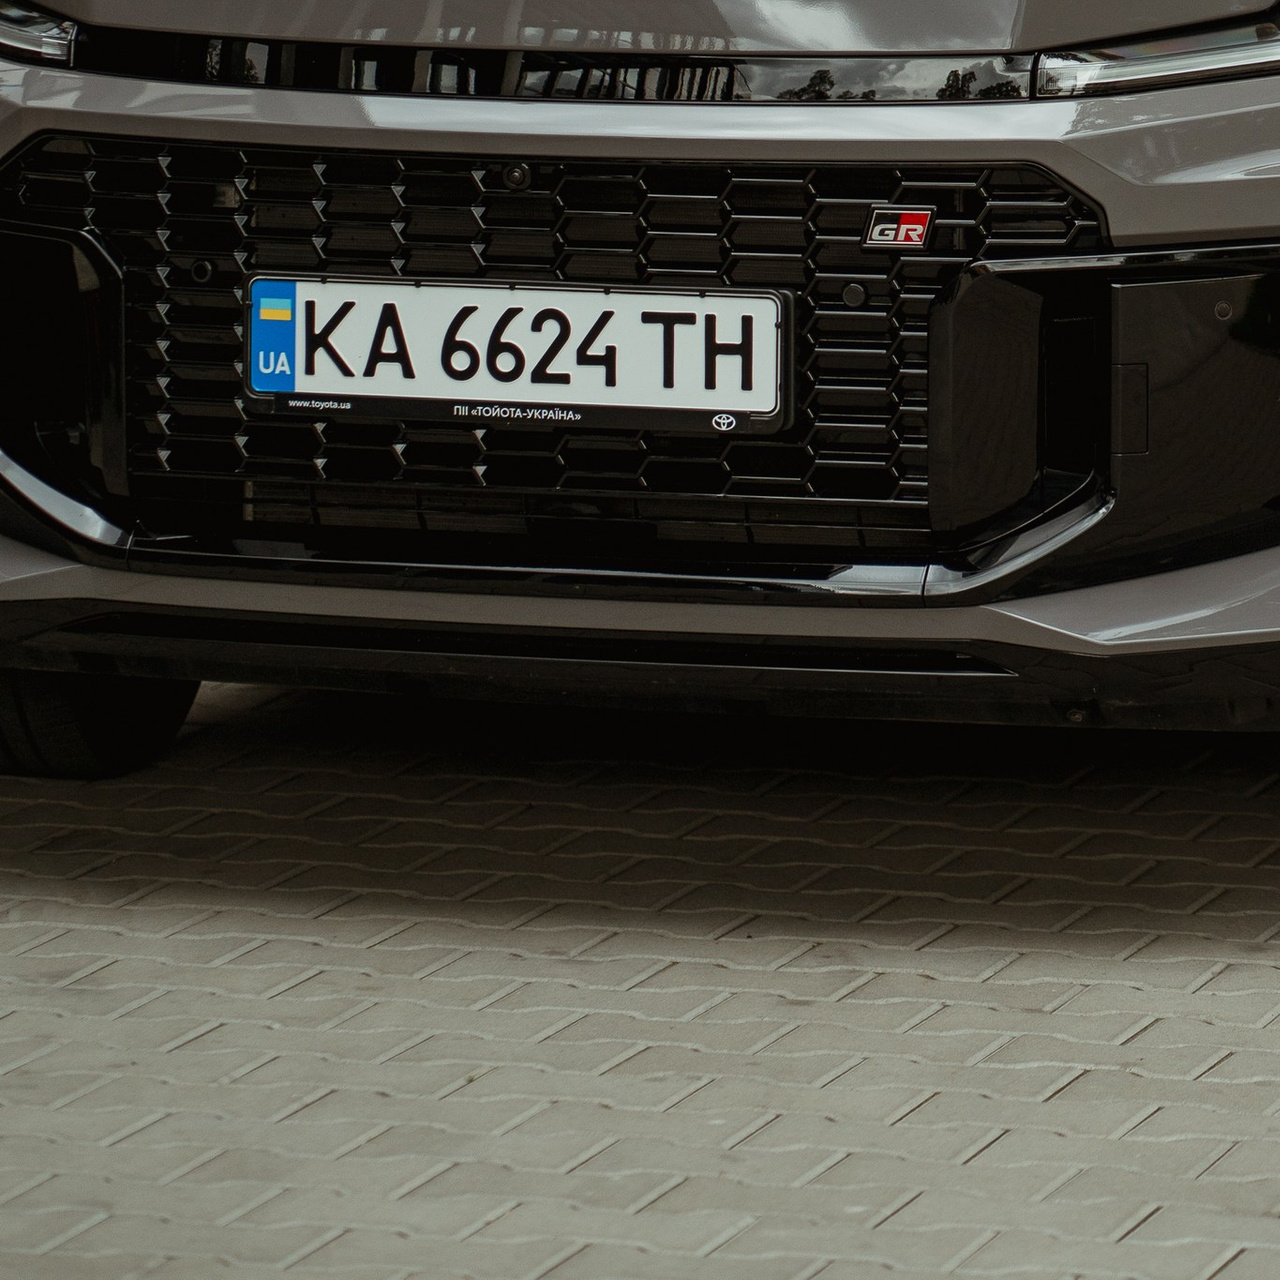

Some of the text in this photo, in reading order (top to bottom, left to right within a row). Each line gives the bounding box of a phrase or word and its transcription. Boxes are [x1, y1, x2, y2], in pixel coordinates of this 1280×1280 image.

[871, 224, 923, 241] GR
[304, 300, 754, 391] KA 6624 TH
[258, 351, 291, 375] UA
[288, 400, 351, 410] www.toyota.ua
